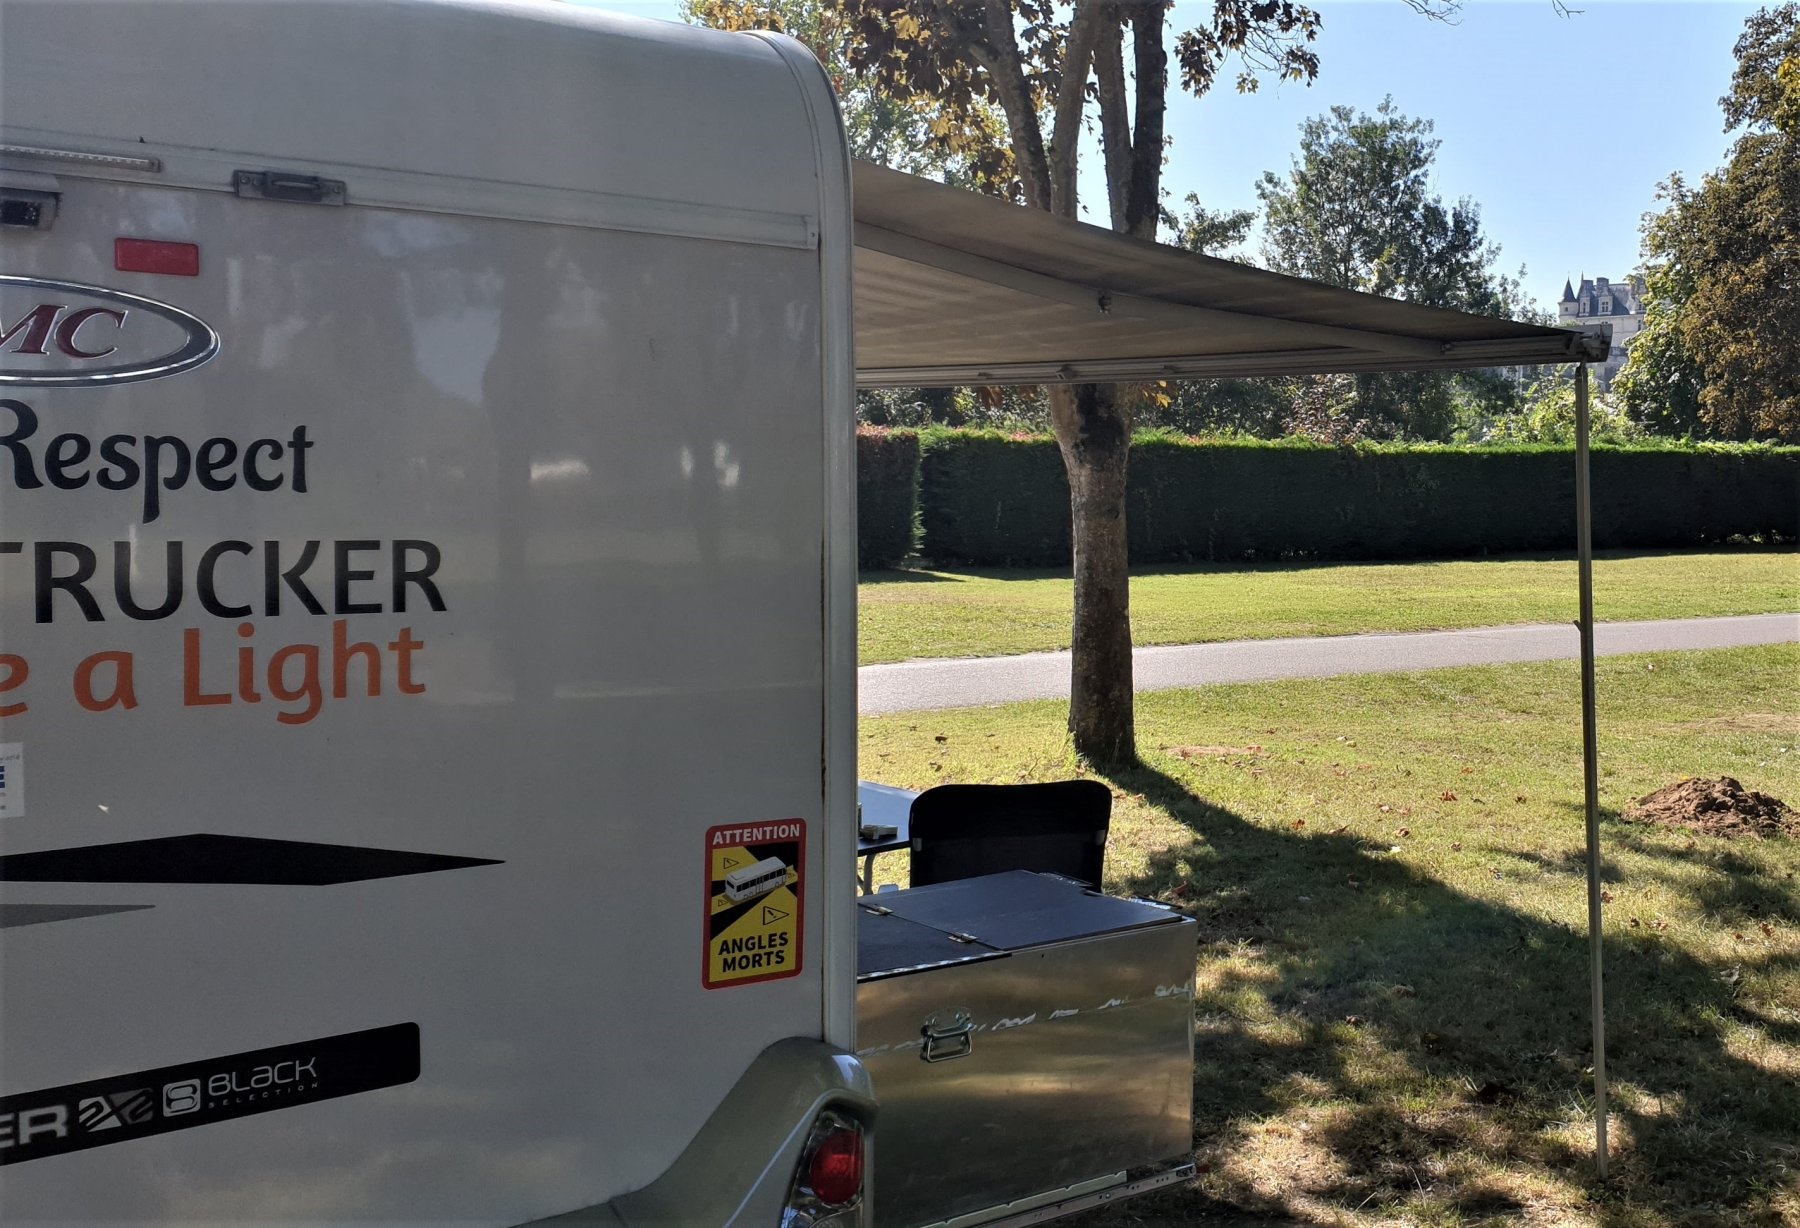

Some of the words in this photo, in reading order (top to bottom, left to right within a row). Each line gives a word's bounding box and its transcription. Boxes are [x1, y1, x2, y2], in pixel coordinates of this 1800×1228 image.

[0, 399, 314, 524] Respect
[73, 650, 138, 712] a
[183, 619, 426, 725] Light
[712, 823, 800, 846] ATTENTION
[718, 931, 789, 956] ANGLES
[722, 950, 785, 973] MORTS
[207, 1080, 319, 1109] SELECTION
